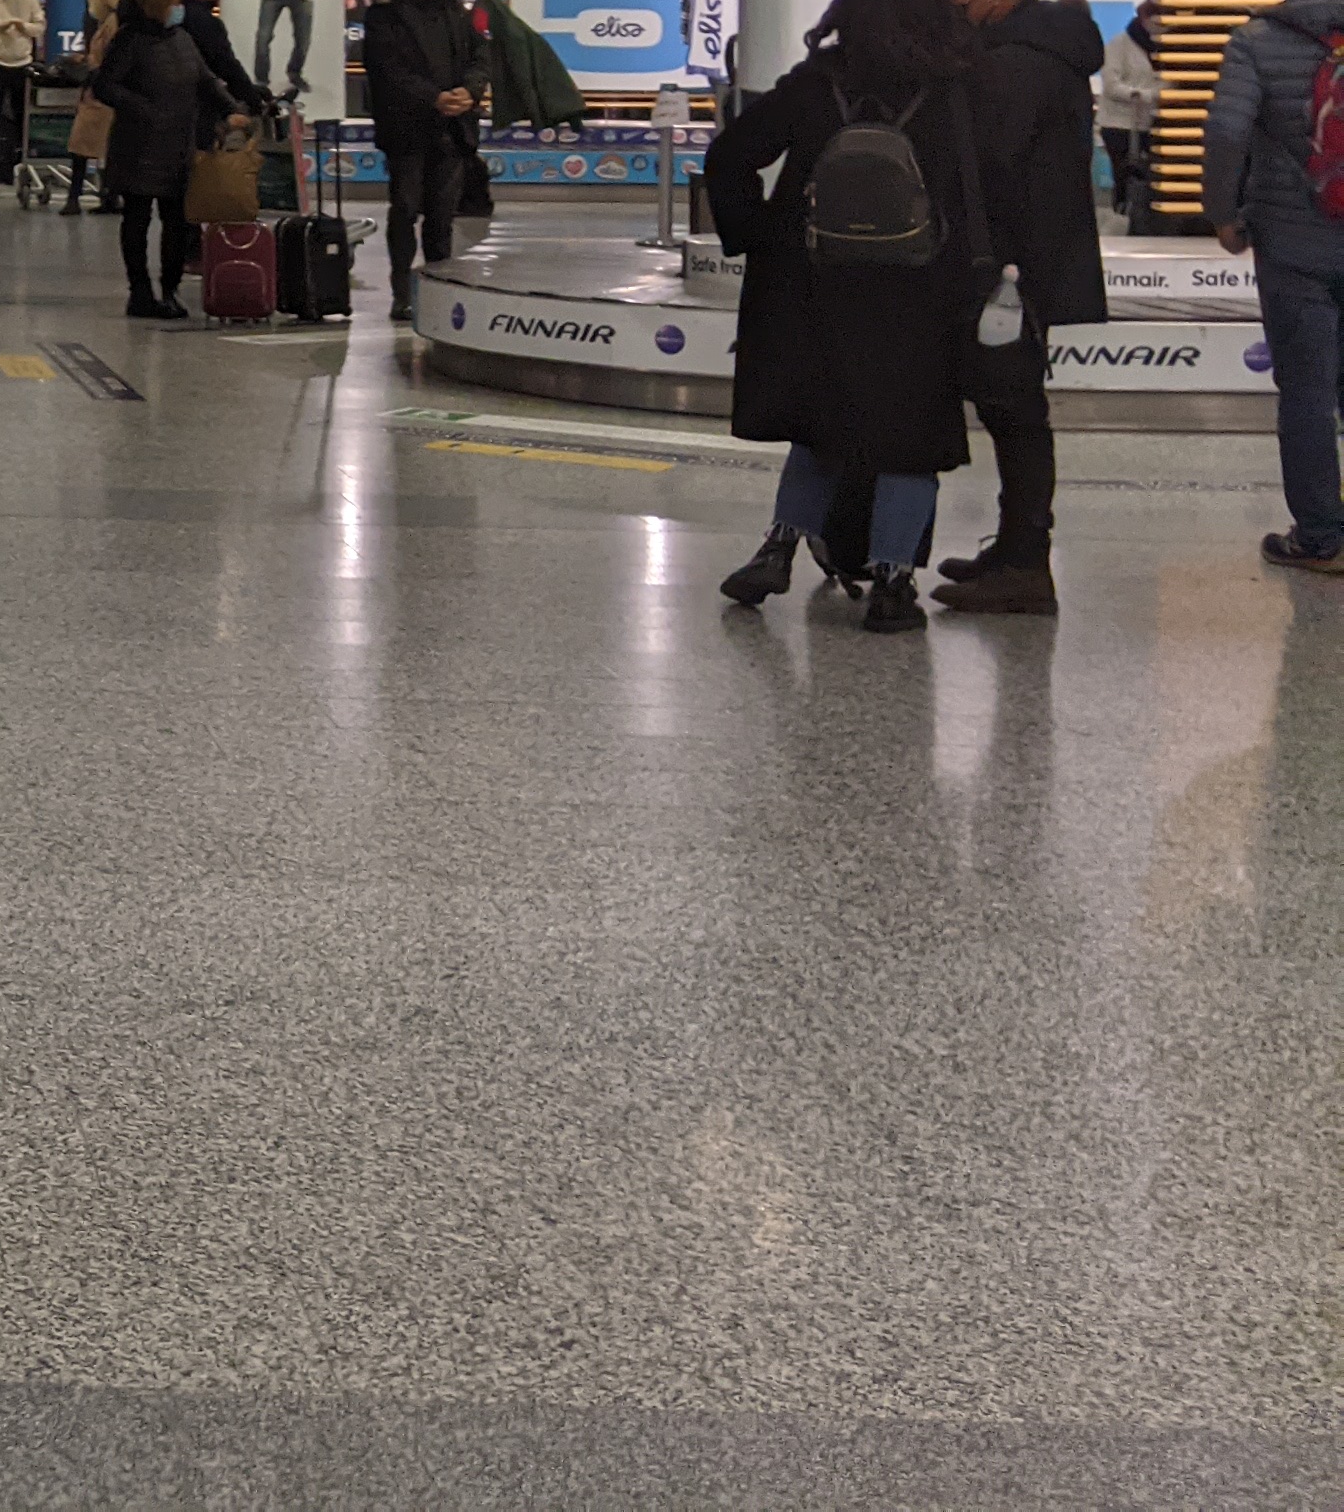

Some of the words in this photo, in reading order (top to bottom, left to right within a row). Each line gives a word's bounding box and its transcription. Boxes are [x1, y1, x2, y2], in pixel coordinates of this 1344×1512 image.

[590, 15, 646, 38] elisa
[691, 255, 717, 274] Safe
[720, 259, 743, 276] tra
[1105, 270, 1169, 288] innair.
[1191, 269, 1238, 287] Safe
[489, 314, 617, 345] FINNAIR
